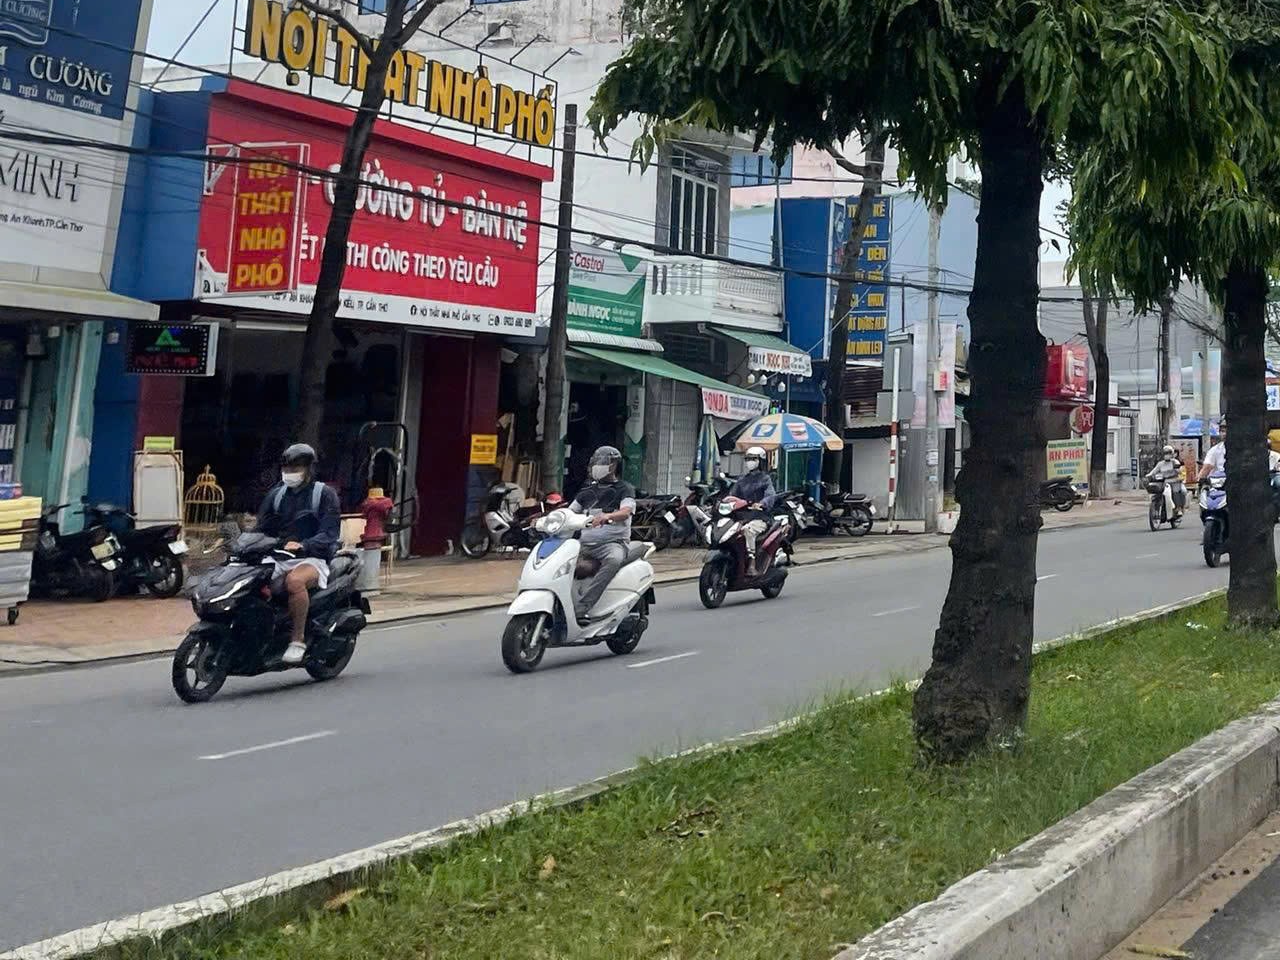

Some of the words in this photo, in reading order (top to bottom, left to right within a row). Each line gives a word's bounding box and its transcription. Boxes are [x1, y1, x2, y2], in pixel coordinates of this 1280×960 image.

[30, 53, 113, 96] CƯƠNG
[425, 59, 493, 129] NHÀ
[493, 84, 556, 147] PHỐ
[239, 188, 294, 216] THẤT
[417, 172, 446, 227] TỦ
[462, 188, 502, 239] BÀN
[503, 200, 529, 250] KỆ
[240, 222, 286, 252] NHÀ
[235, 255, 284, 287] PHỐ
[346, 241, 369, 268] THI
[371, 242, 409, 275] CÔNG
[413, 253, 446, 280] THEO
[448, 255, 473, 284] YÊU
[475, 255, 499, 288] CẦU
[574, 252, 605, 273] Castrol
